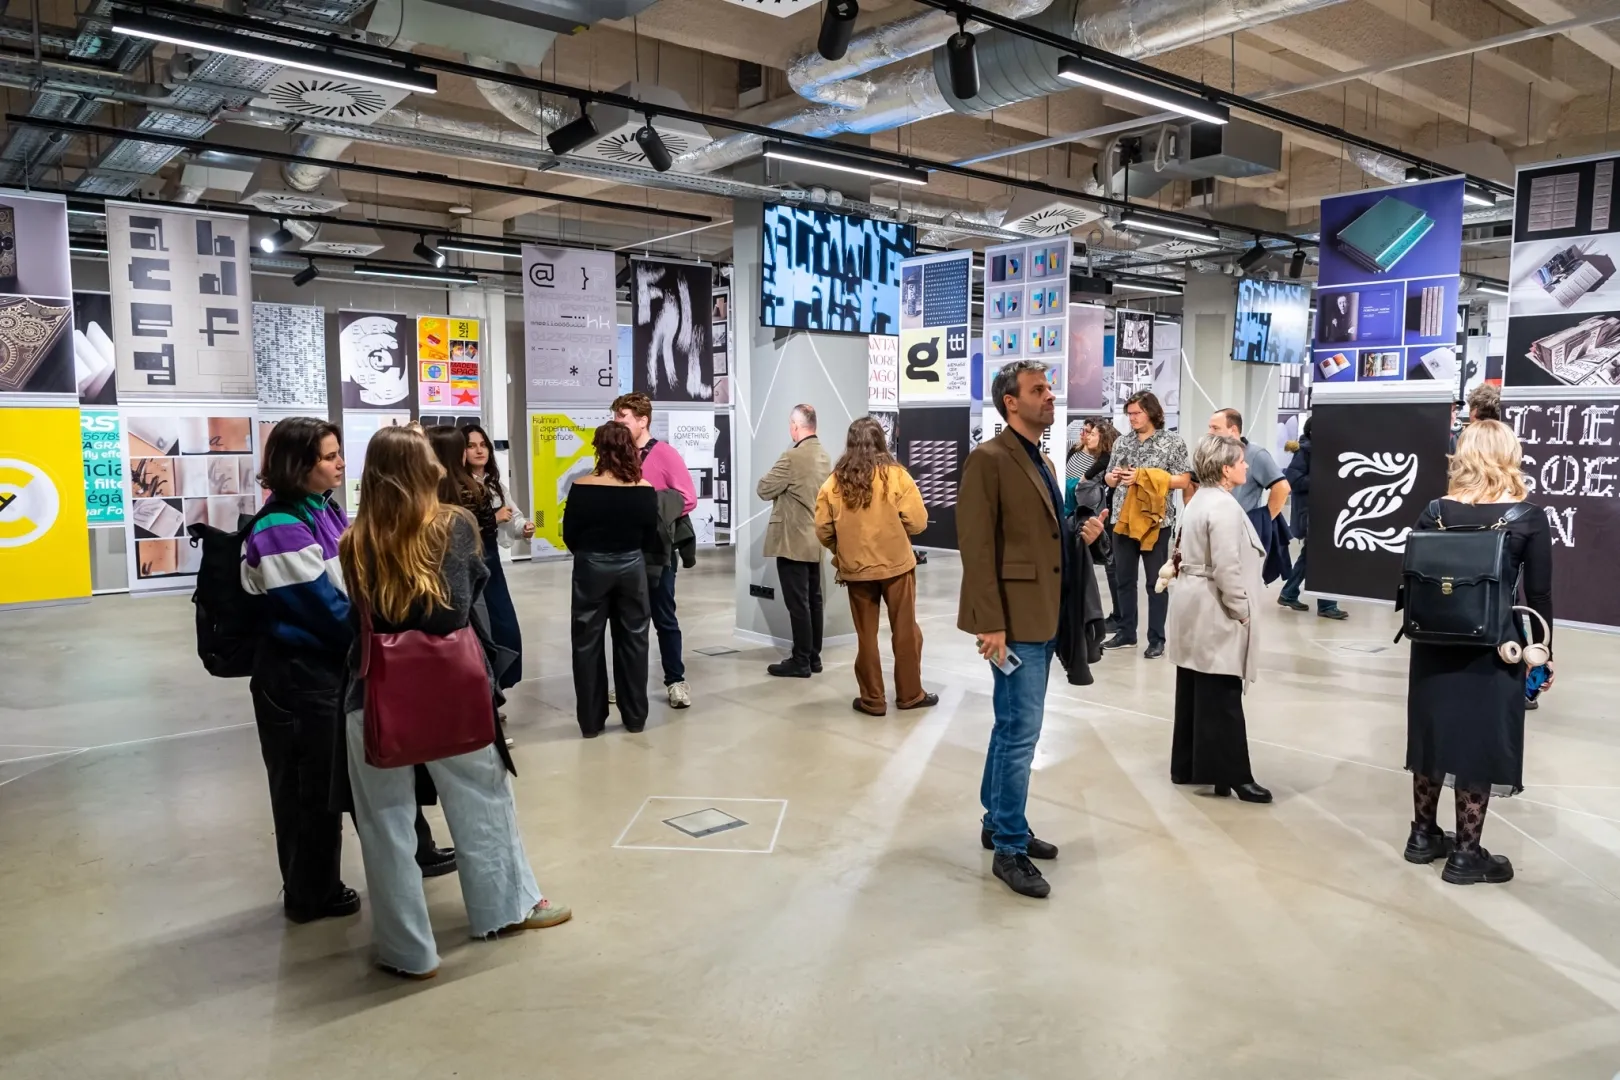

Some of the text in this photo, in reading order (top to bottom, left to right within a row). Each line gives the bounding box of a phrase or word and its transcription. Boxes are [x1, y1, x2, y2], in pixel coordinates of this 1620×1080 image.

[676, 425, 706, 433] COOKING
[673, 432, 710, 441] SOMETHING
[685, 439, 700, 447] NEW
